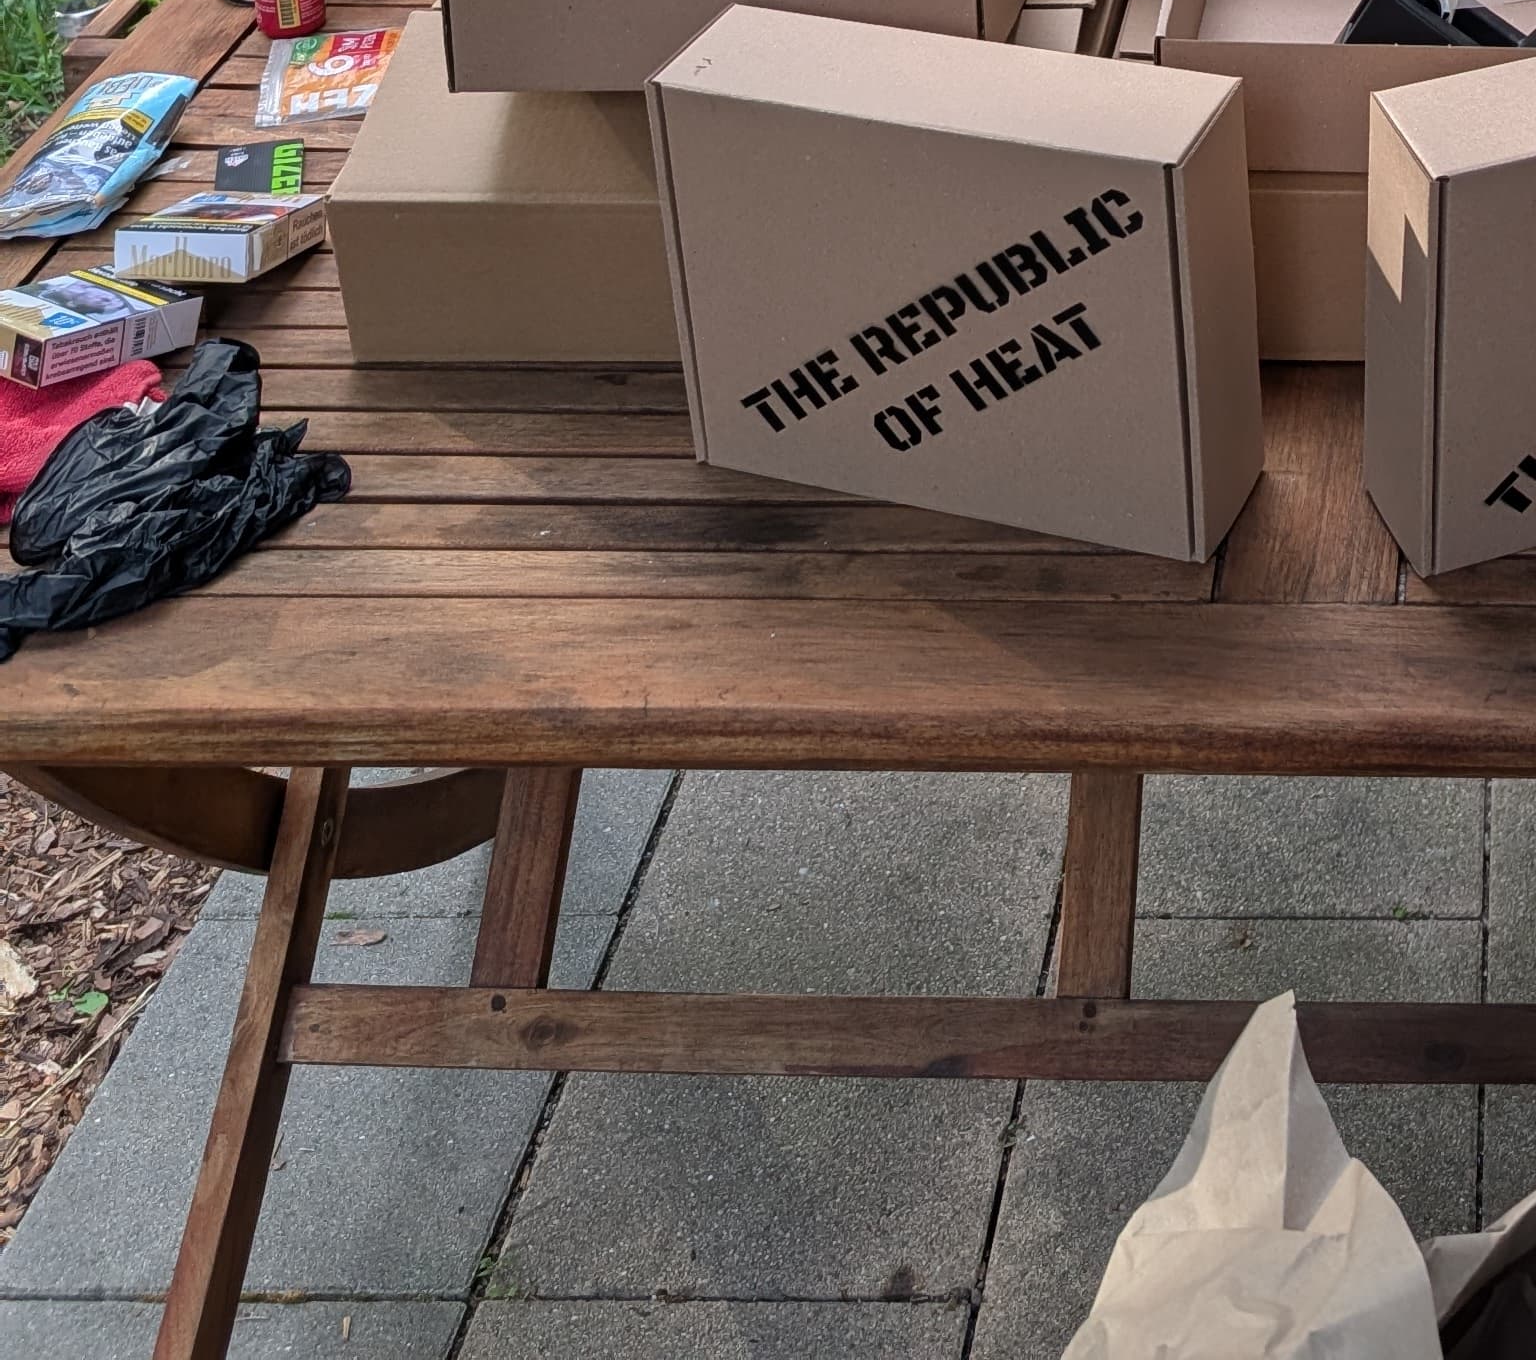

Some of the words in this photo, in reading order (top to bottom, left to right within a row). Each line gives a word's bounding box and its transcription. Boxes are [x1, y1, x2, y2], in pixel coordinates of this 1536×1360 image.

[289, 83, 378, 116] ZEH
[131, 236, 232, 278] Marlboro
[740, 349, 860, 433] THE
[849, 189, 1144, 376] REPUBLIC
[873, 384, 943, 451] OF
[949, 302, 1101, 412] HEAT
